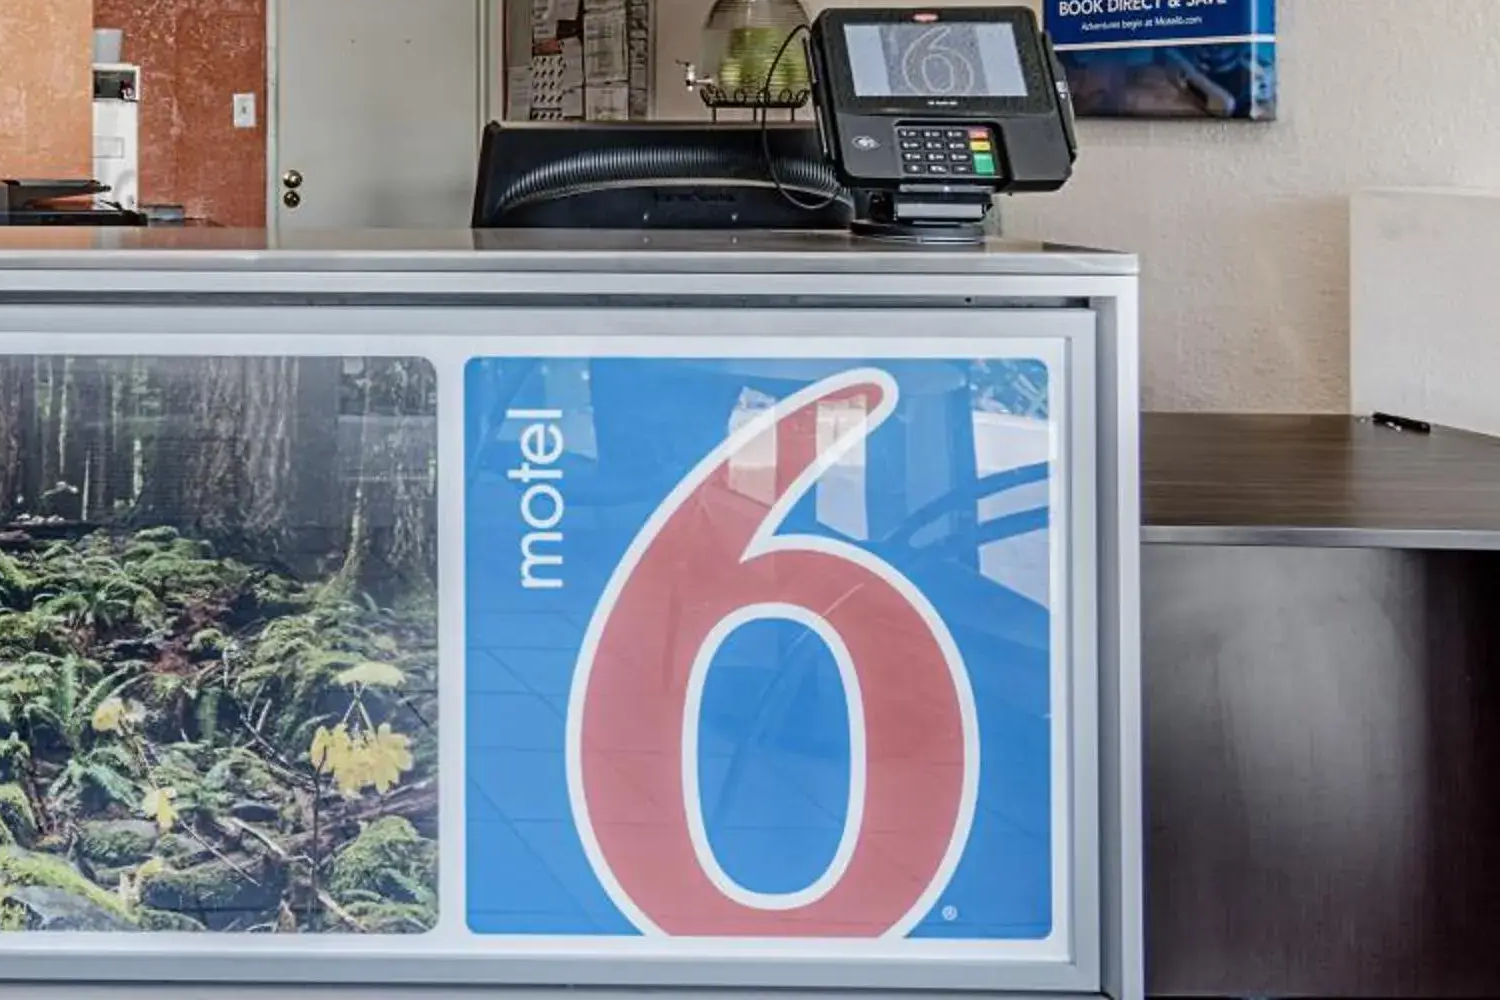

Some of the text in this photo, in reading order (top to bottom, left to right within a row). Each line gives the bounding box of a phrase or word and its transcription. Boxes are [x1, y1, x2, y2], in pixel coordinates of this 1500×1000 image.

[902, 25, 974, 96] 6
[1121, 18, 1143, 33] begin
[1144, 18, 1153, 27] at
[507, 366, 981, 938] motel 6
